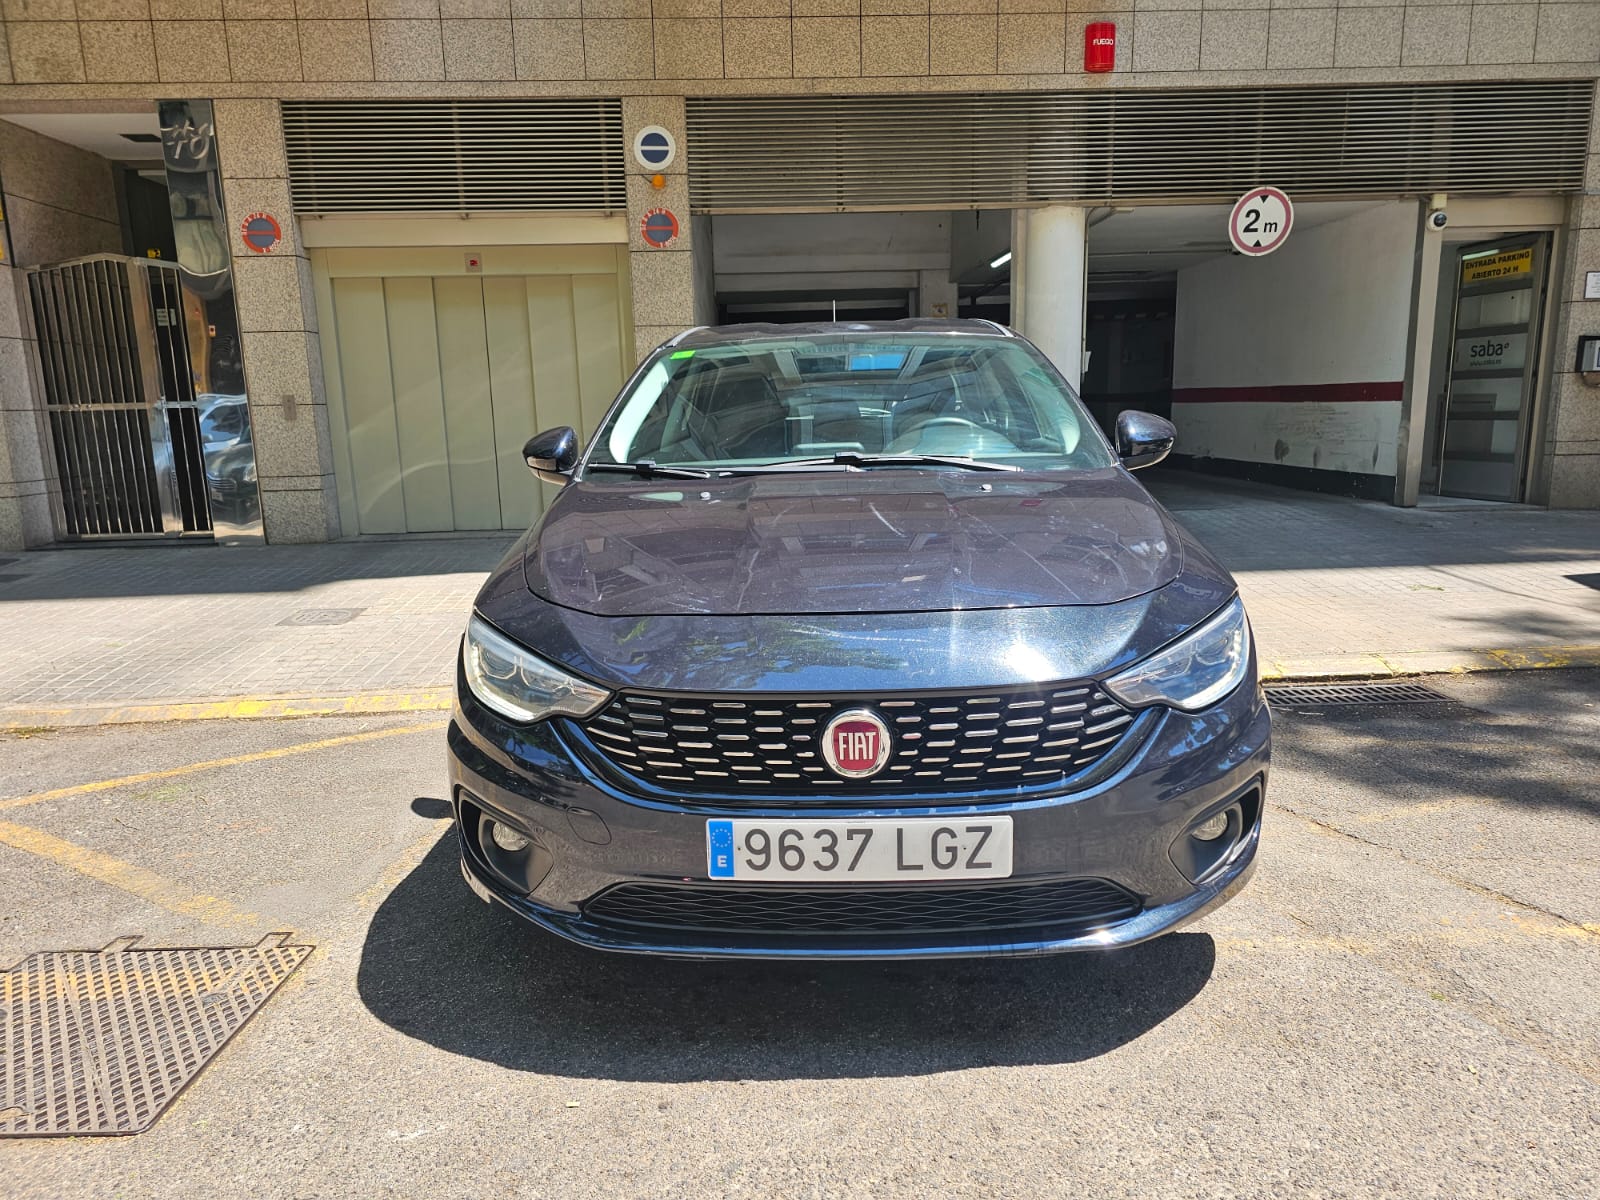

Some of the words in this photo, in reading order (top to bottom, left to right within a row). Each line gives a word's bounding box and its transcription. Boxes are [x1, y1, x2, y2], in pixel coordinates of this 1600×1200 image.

[1093, 38, 1113, 46] FUEGO
[1243, 208, 1260, 233] 2
[1263, 221, 1278, 233] m
[1465, 259, 1497, 270] ENTRADA
[1498, 250, 1530, 264] PARKING
[1471, 268, 1502, 280] ABIERTO
[1502, 266, 1512, 275] 24
[1512, 265, 1519, 273] H
[1470, 340, 1504, 358] saba
[838, 731, 876, 761] FIAT
[744, 828, 874, 872] 9637
[896, 825, 993, 872] LGZ
[717, 855, 728, 868] E
